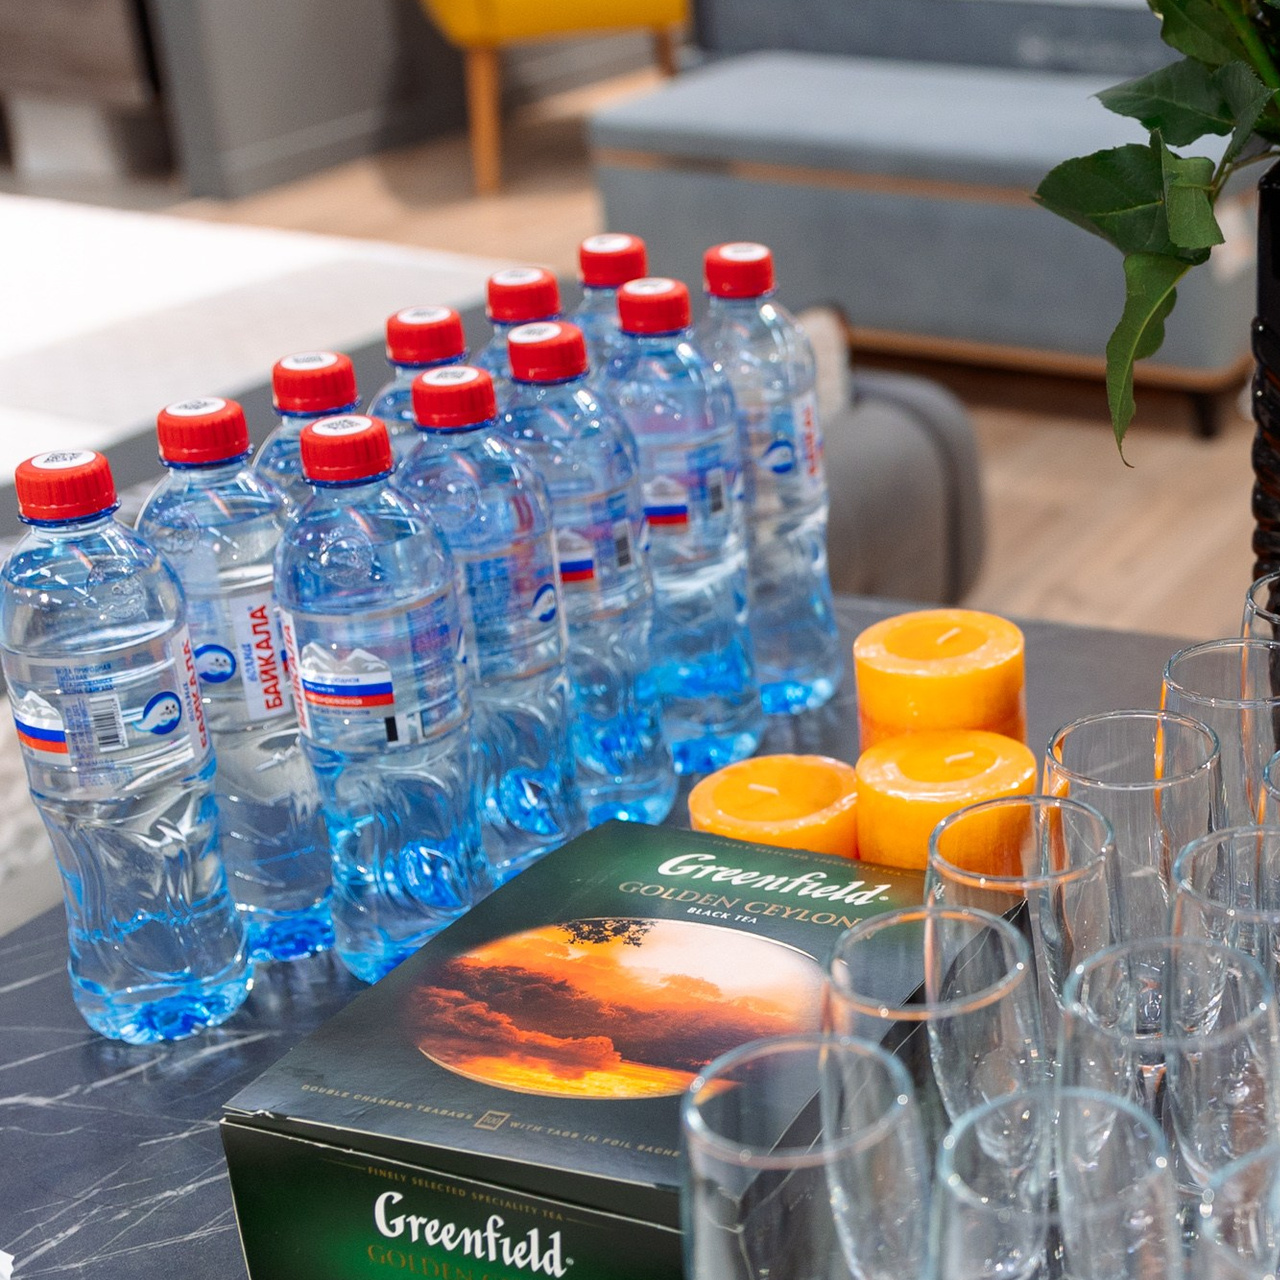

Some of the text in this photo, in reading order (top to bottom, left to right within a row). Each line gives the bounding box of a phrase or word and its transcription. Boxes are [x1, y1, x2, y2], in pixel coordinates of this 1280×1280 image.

[618, 881, 863, 929] GOLDEN CEYLON
[657, 853, 891, 906] Greenfield
[687, 906, 757, 924] BLACK TEA
[301, 1083, 351, 1099] DOUBLE
[353, 1092, 414, 1111] CHAMBER
[416, 1104, 473, 1121] TEABAGS
[509, 1121, 543, 1133] WITH
[546, 1127, 580, 1139] TAGS
[583, 1134, 598, 1143] IN
[601, 1137, 633, 1150] FOIL
[636, 1144, 682, 1159] SACHE
[368, 1166, 564, 1222] FINELY SELECTED SPECIALITY TEA
[374, 1191, 568, 1279] Greenfield
